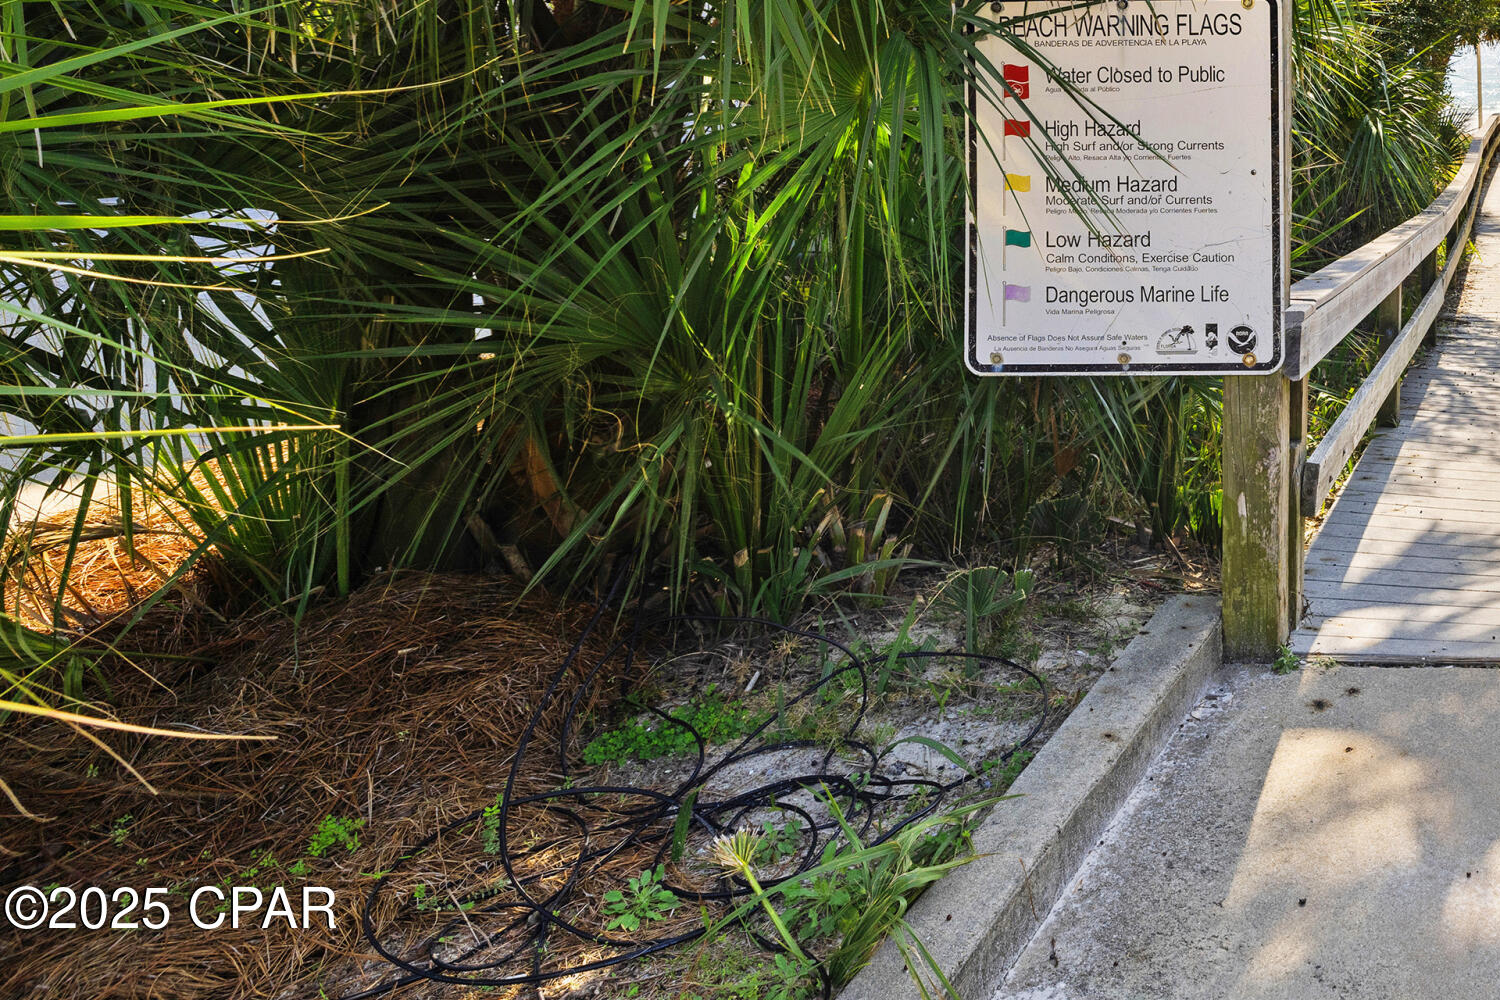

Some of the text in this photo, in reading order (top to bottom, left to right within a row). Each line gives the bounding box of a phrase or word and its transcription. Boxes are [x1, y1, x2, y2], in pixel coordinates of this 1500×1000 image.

[1075, 14, 1169, 37] WARNING
[1177, 13, 1242, 36] FLAGS
[1097, 66, 1152, 83] Closed
[1158, 67, 1172, 83] to
[1178, 65, 1225, 83] Public
[1045, 120, 1140, 140] High Hazard
[1046, 230, 1150, 248] Low Hazard
[1046, 252, 1234, 264] Calm Conditions, Exercise Caution
[1046, 285, 1228, 307] Dangerous Marine Life
